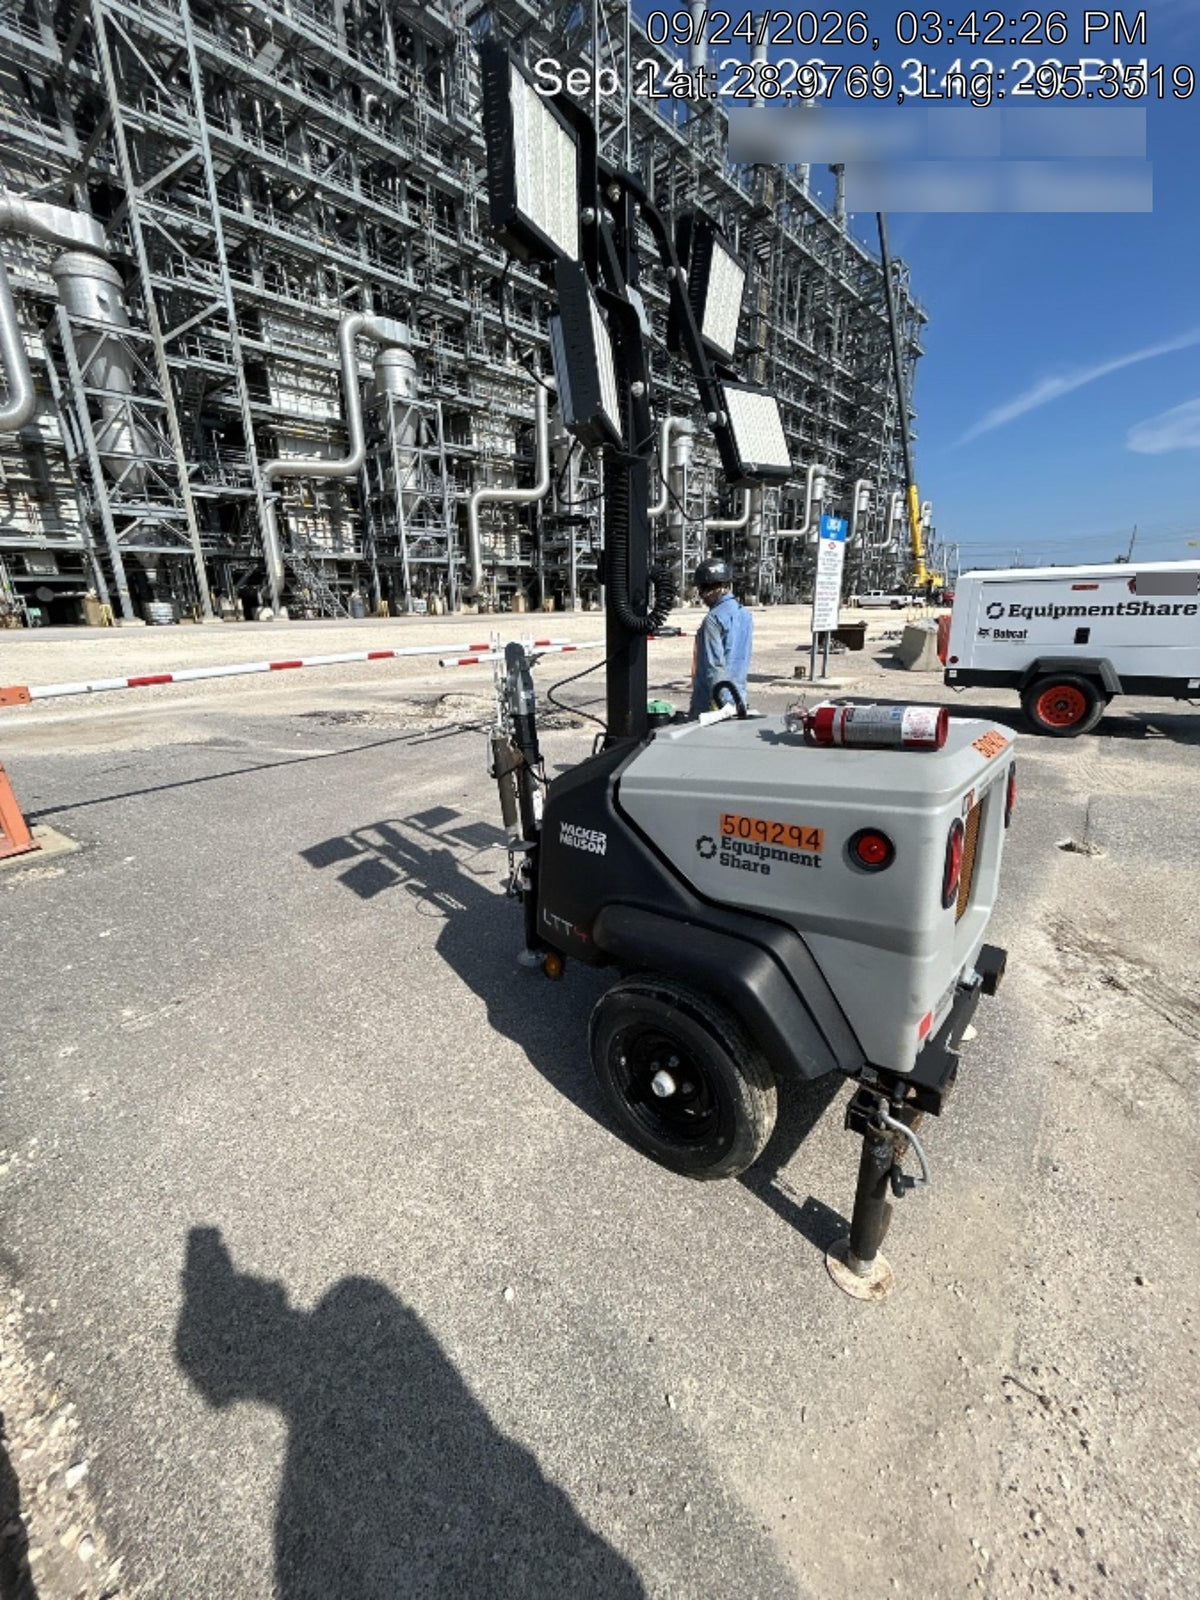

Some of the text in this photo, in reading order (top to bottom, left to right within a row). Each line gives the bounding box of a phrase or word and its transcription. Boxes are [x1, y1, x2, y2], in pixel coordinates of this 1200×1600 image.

[1008, 601, 1198, 620] EquipmentShare
[560, 821, 607, 844] WACKER
[723, 814, 819, 850] 509294
[560, 833, 606, 855] NEUSON
[720, 836, 822, 868] Equipment
[719, 852, 771, 875] Share
